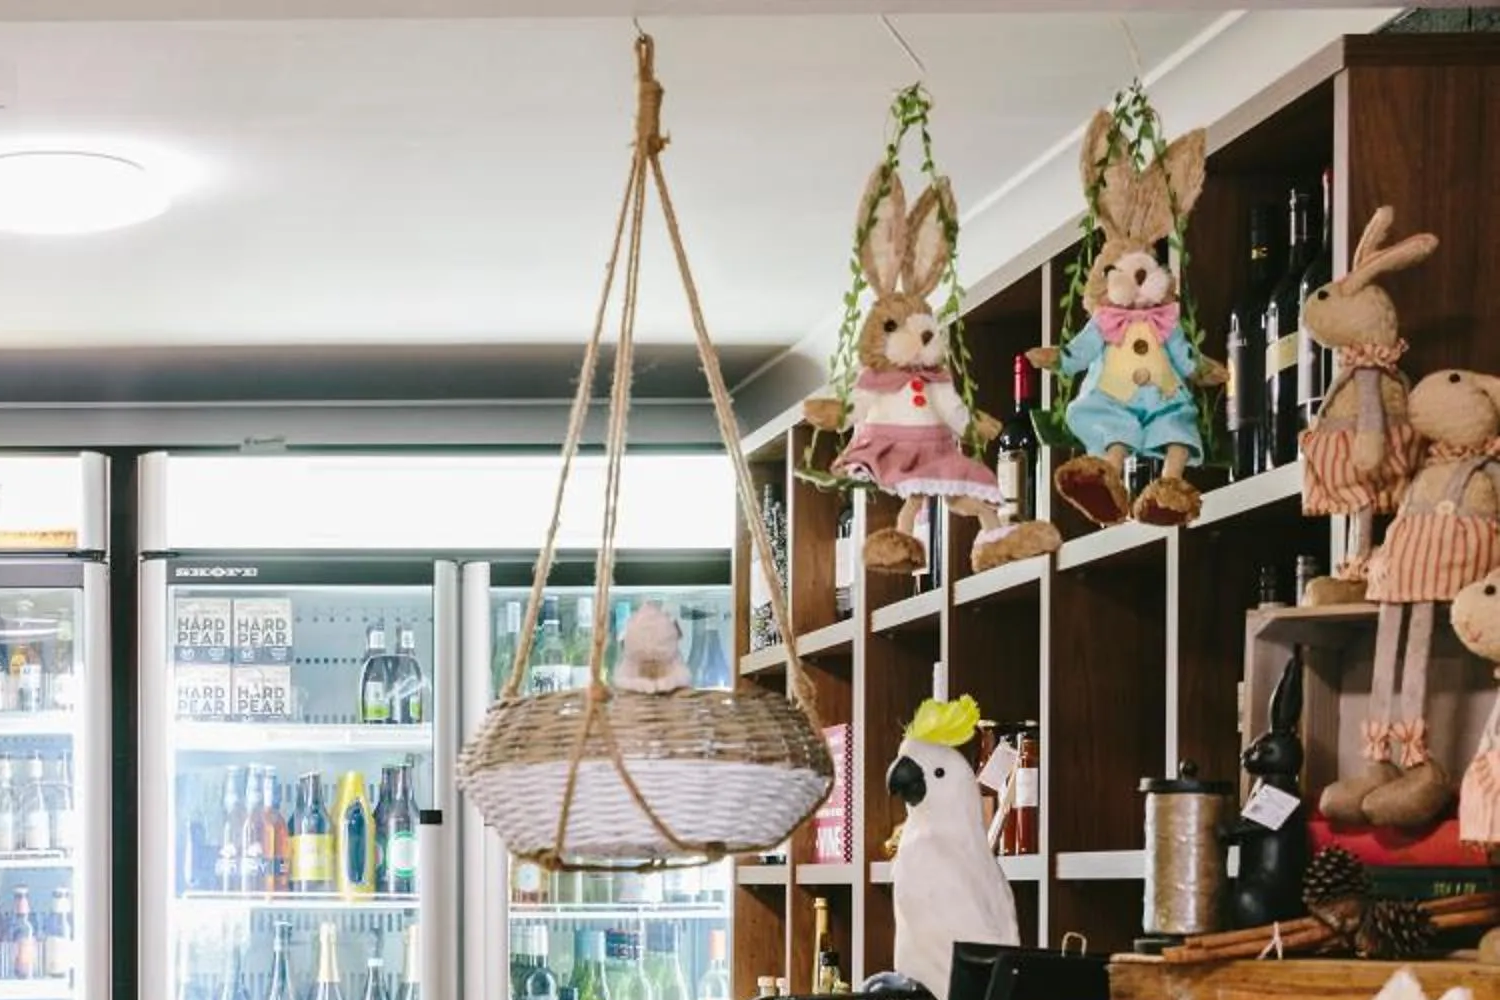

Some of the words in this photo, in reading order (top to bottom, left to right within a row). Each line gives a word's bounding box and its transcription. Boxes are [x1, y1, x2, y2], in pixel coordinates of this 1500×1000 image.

[178, 616, 225, 631] HARD
[237, 616, 287, 631] HARD
[178, 631, 225, 645] PEAR
[237, 631, 288, 645] PEAR
[178, 686, 225, 699] HARD
[237, 686, 285, 699] HARD
[178, 700, 225, 714] PEAR
[237, 700, 285, 713] PEAR
